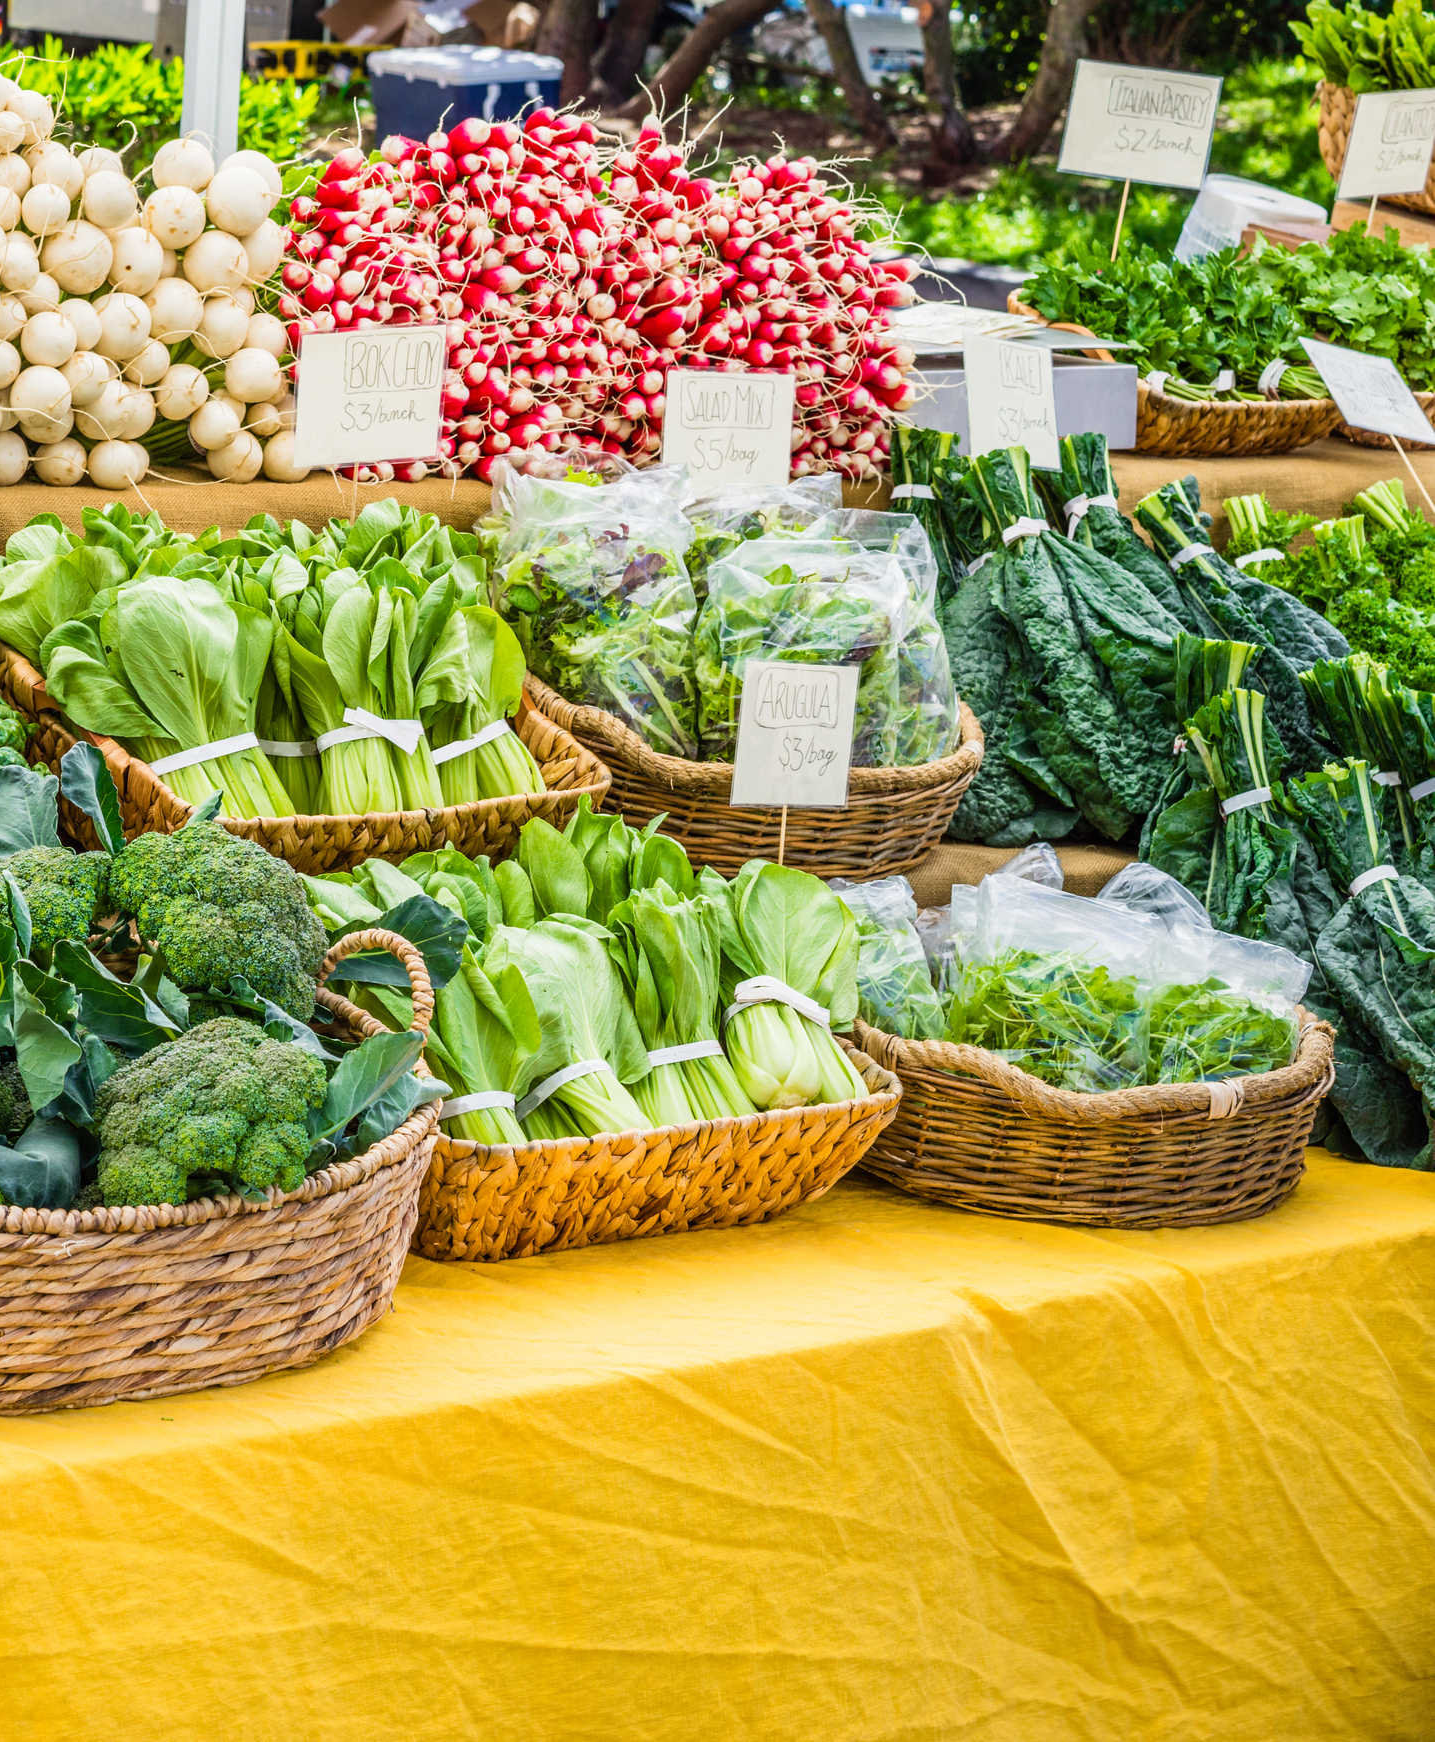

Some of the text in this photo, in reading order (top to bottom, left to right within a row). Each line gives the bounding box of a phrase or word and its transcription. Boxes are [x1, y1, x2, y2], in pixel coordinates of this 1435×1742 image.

[1113, 80, 1210, 124] ITALIAN PARSLEY
[1115, 124, 1202, 156] $2/bunch
[349, 337, 439, 389] BOK CHOY
[1004, 347, 1036, 389] KALE
[341, 399, 425, 433] $3/bunch
[686, 380, 765, 424] SALAD MIX
[998, 405, 1055, 442] $3/bunch
[691, 433, 760, 474] $5/bag
[758, 673, 831, 721] ARUGULA
[778, 730, 838, 776] $3/bag
